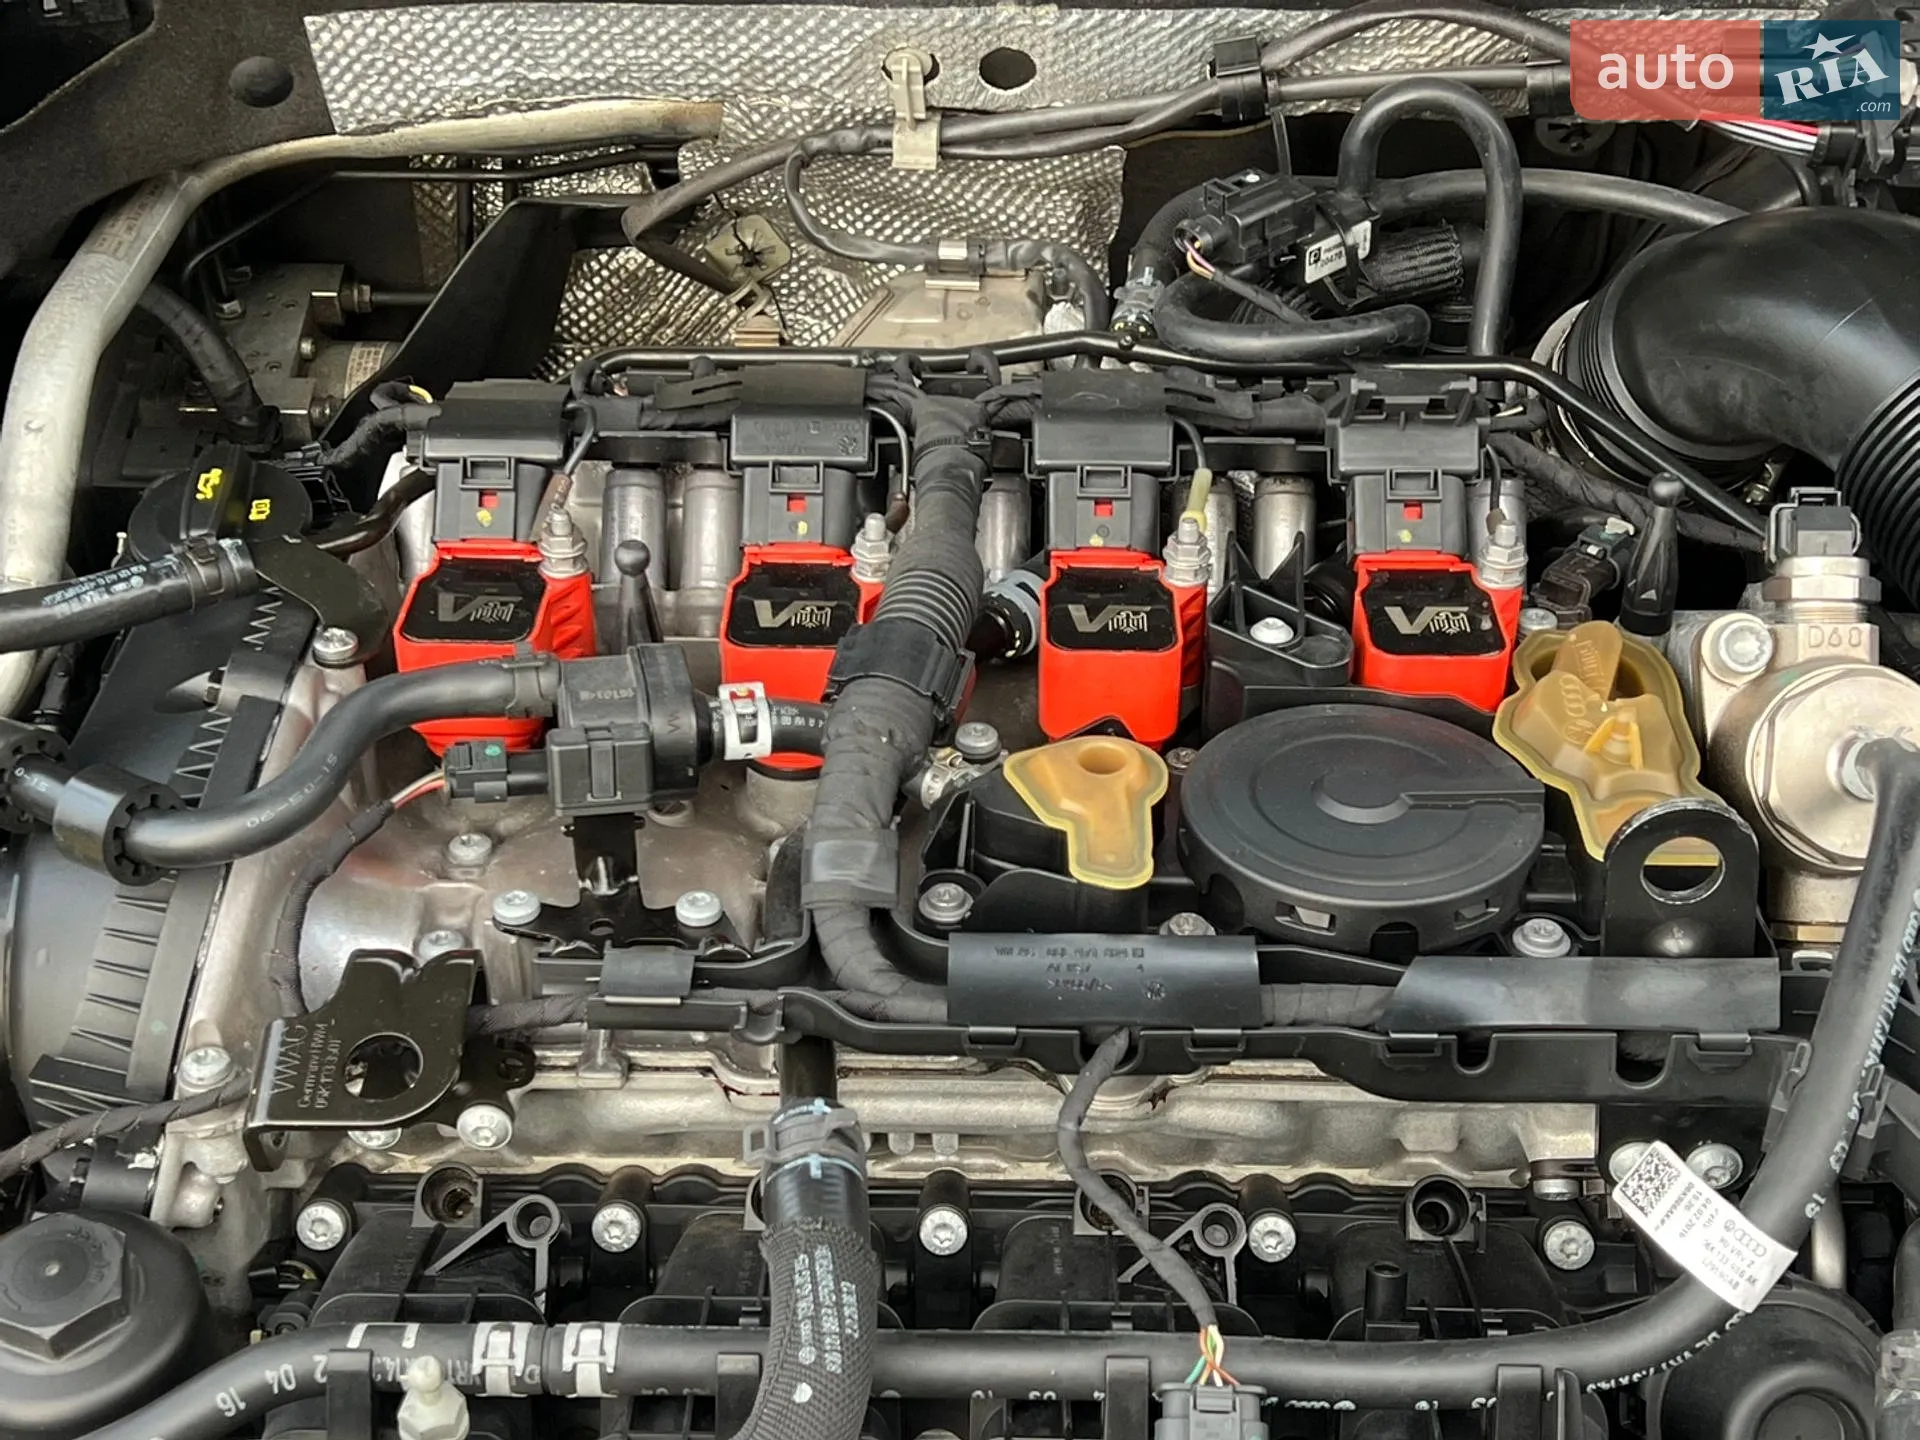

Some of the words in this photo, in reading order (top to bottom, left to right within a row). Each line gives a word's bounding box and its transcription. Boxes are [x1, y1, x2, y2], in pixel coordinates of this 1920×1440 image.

[269, 1025, 308, 1094] VWAG
[263, 1363, 299, 1395] 04
[214, 1387, 248, 1419] 16
